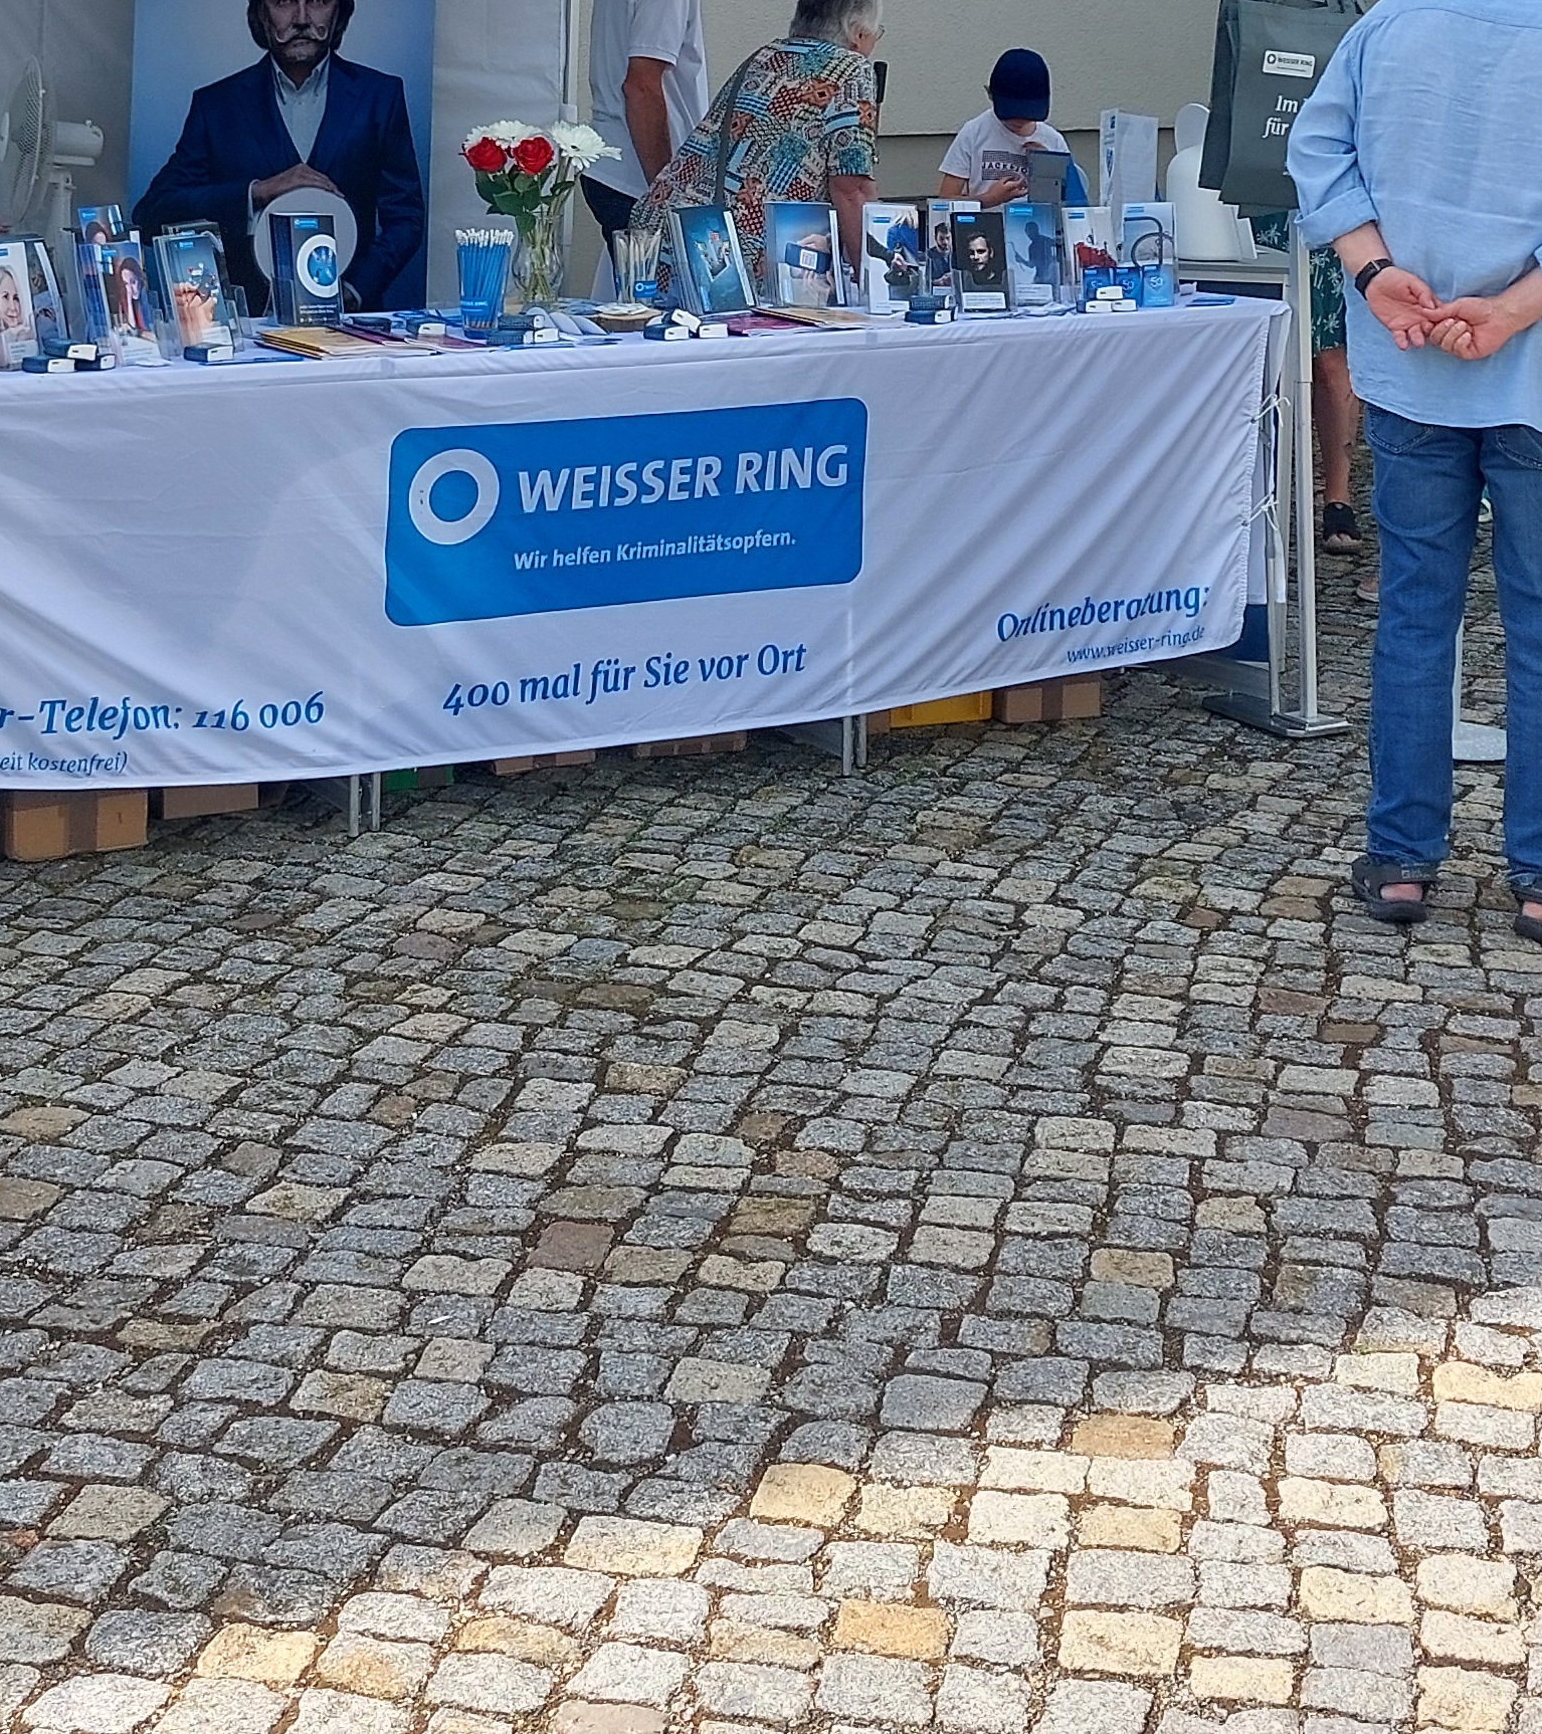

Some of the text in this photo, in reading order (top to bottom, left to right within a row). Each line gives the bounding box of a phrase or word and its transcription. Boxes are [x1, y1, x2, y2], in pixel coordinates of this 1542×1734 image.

[1261, 116, 1290, 139] für
[518, 444, 849, 514] WEISSER RING
[513, 529, 797, 571] Wir helfen Kriminalitätsopfern.
[996, 586, 1211, 642] Onlineberatung:
[1066, 624, 1206, 663] www.weisser-ring.de
[442, 642, 807, 717] 400 mal für Sie vor Ort
[191, 703, 251, 732] 116
[259, 690, 326, 729] 006
[27, 751, 129, 776] kostenfrei)
